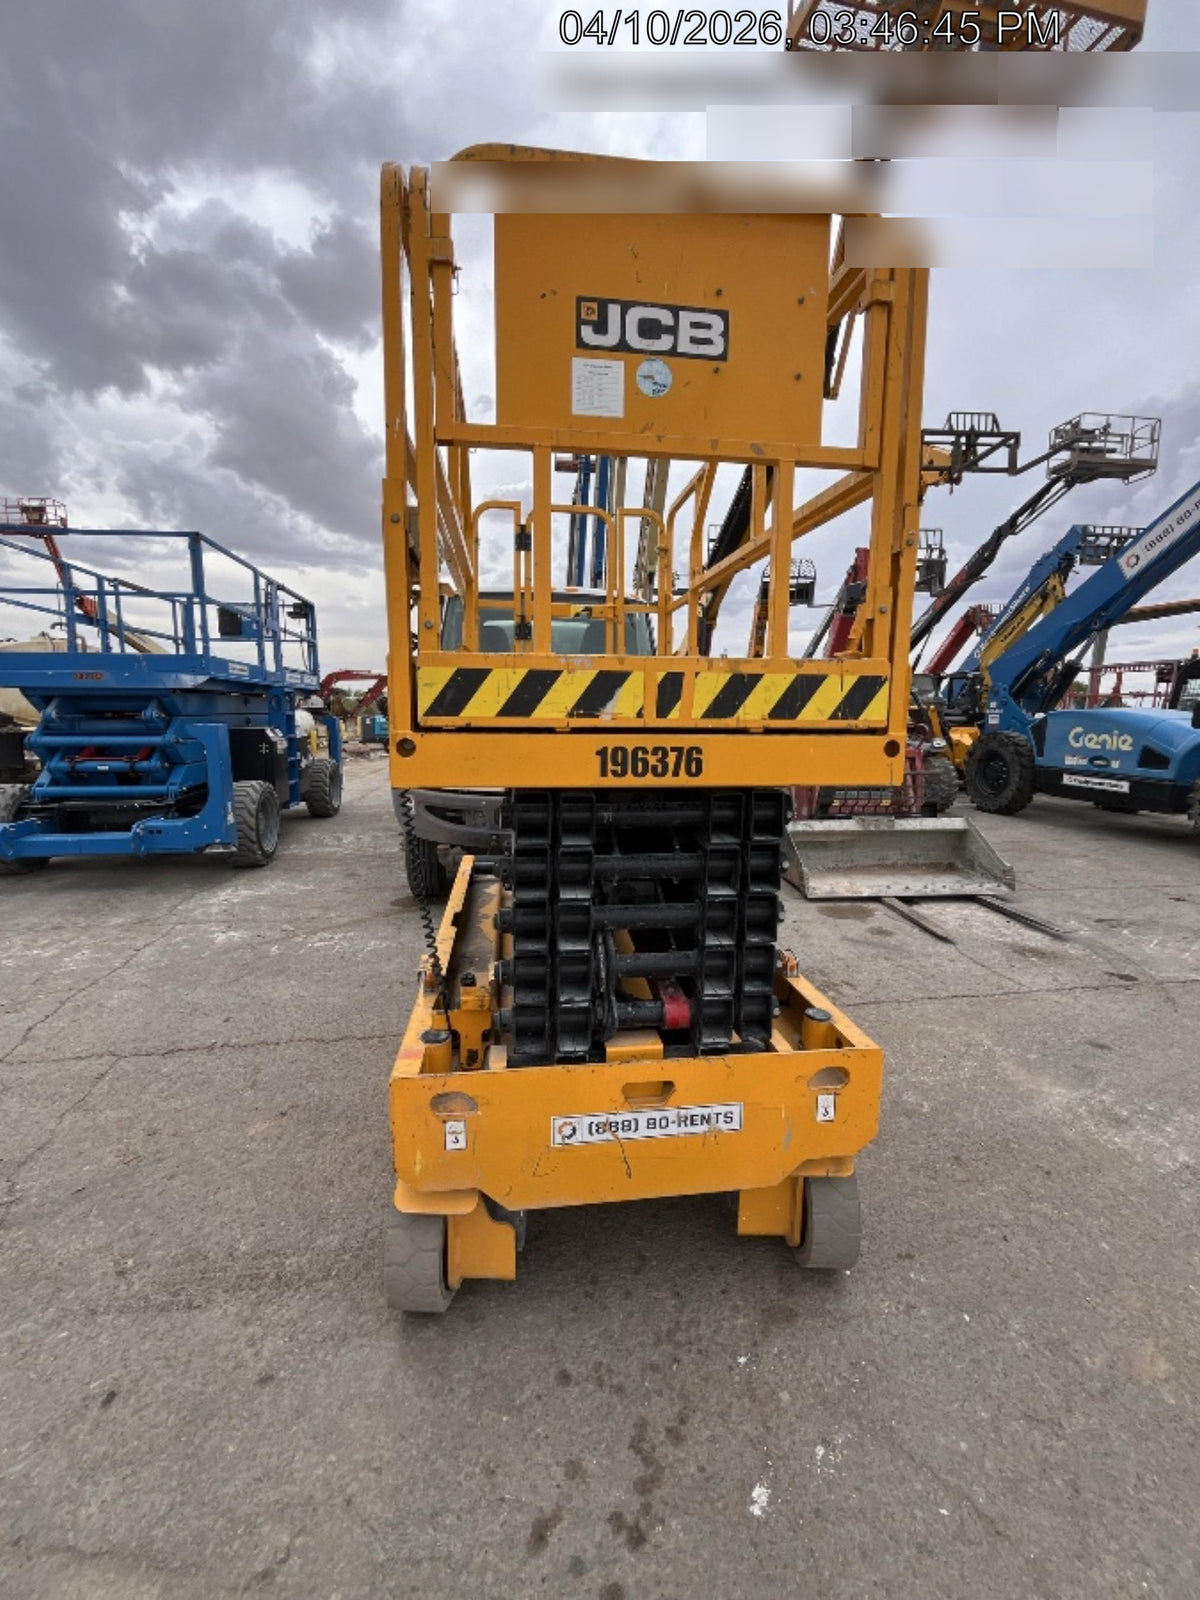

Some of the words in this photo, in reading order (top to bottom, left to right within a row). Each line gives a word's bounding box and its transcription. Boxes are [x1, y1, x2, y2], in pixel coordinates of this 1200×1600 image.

[580, 303, 725, 356] JCB
[1068, 726, 1134, 752] Genie
[595, 745, 703, 778] 196376
[587, 1117, 640, 1137] (888)
[646, 1110, 734, 1130] 80-RENTS
